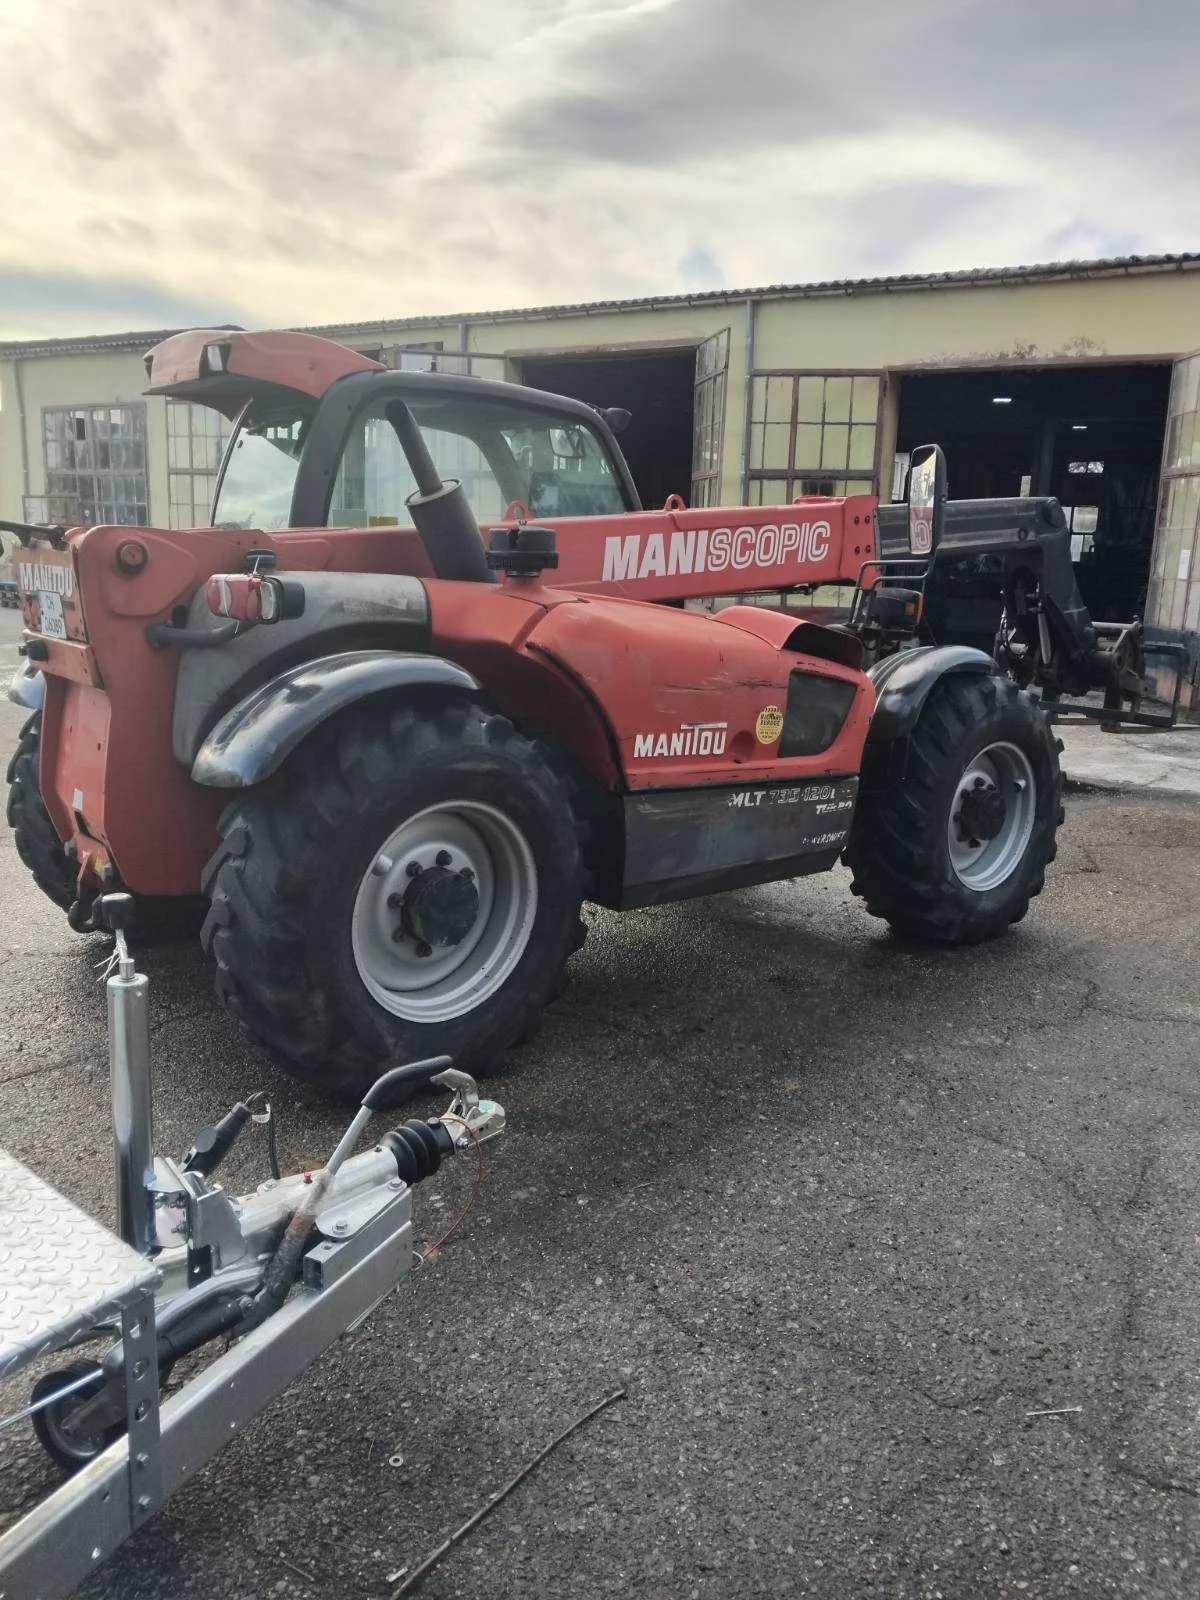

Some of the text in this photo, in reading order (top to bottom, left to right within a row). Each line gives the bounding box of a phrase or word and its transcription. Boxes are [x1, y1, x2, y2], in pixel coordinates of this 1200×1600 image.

[602, 520, 831, 582] MANISCOPIC
[19, 562, 74, 598] MANITOU
[633, 722, 728, 758] MANITOU
[728, 790, 766, 808] MLT
